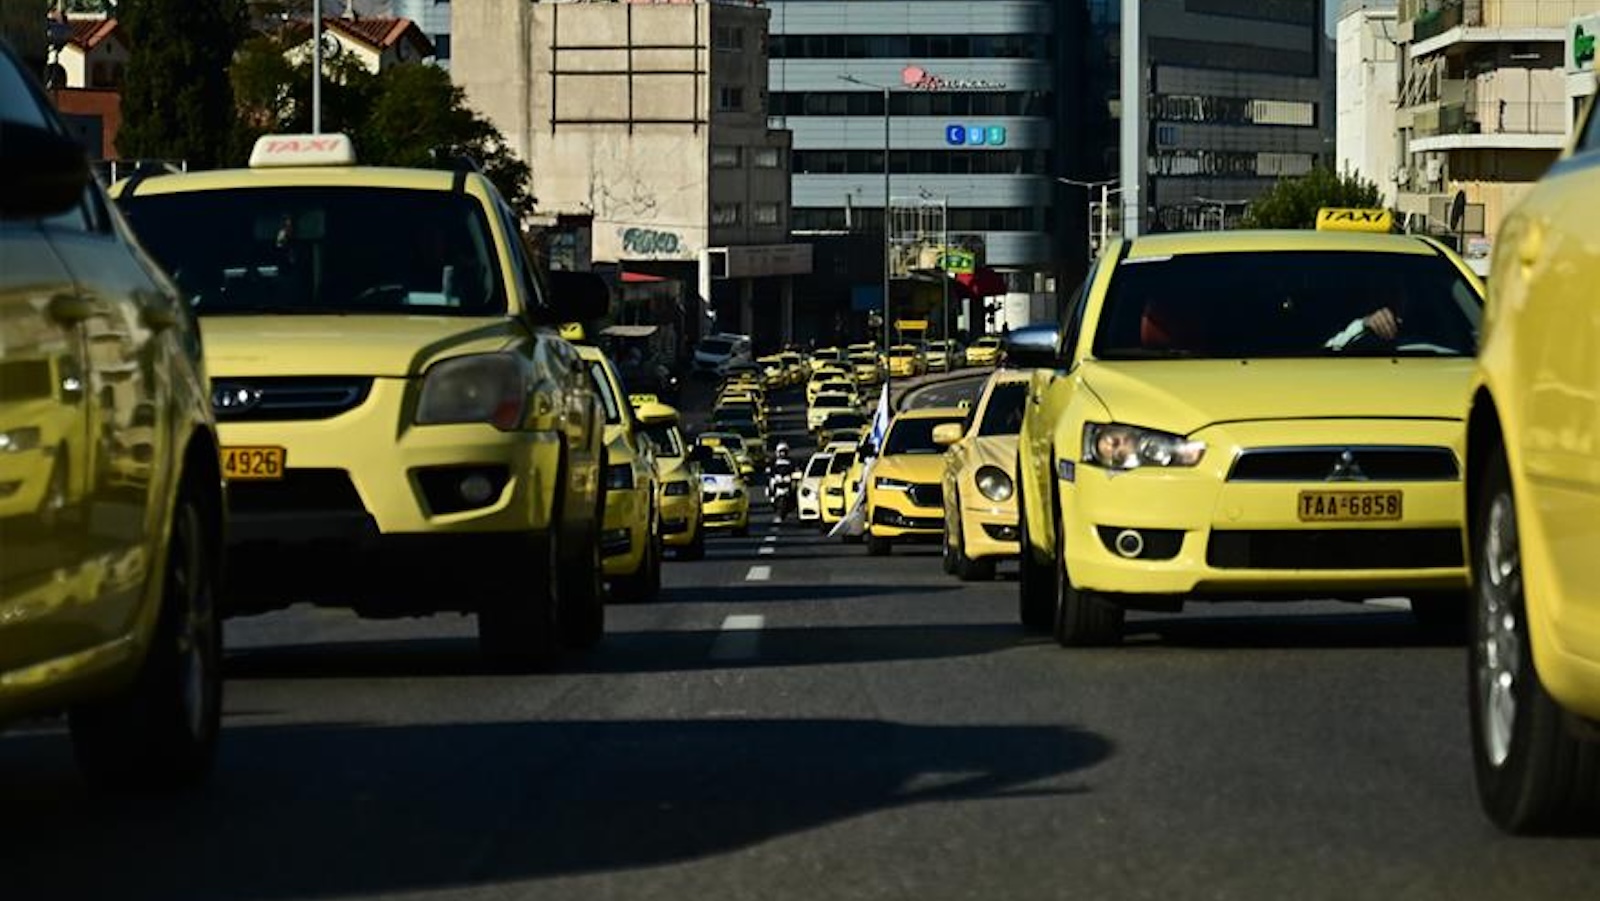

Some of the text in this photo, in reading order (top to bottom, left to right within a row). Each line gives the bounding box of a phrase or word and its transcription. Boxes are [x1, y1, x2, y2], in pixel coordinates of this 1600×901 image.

[264, 139, 341, 154] TAXI
[1321, 210, 1384, 222] TAXI
[225, 450, 279, 475] 4926
